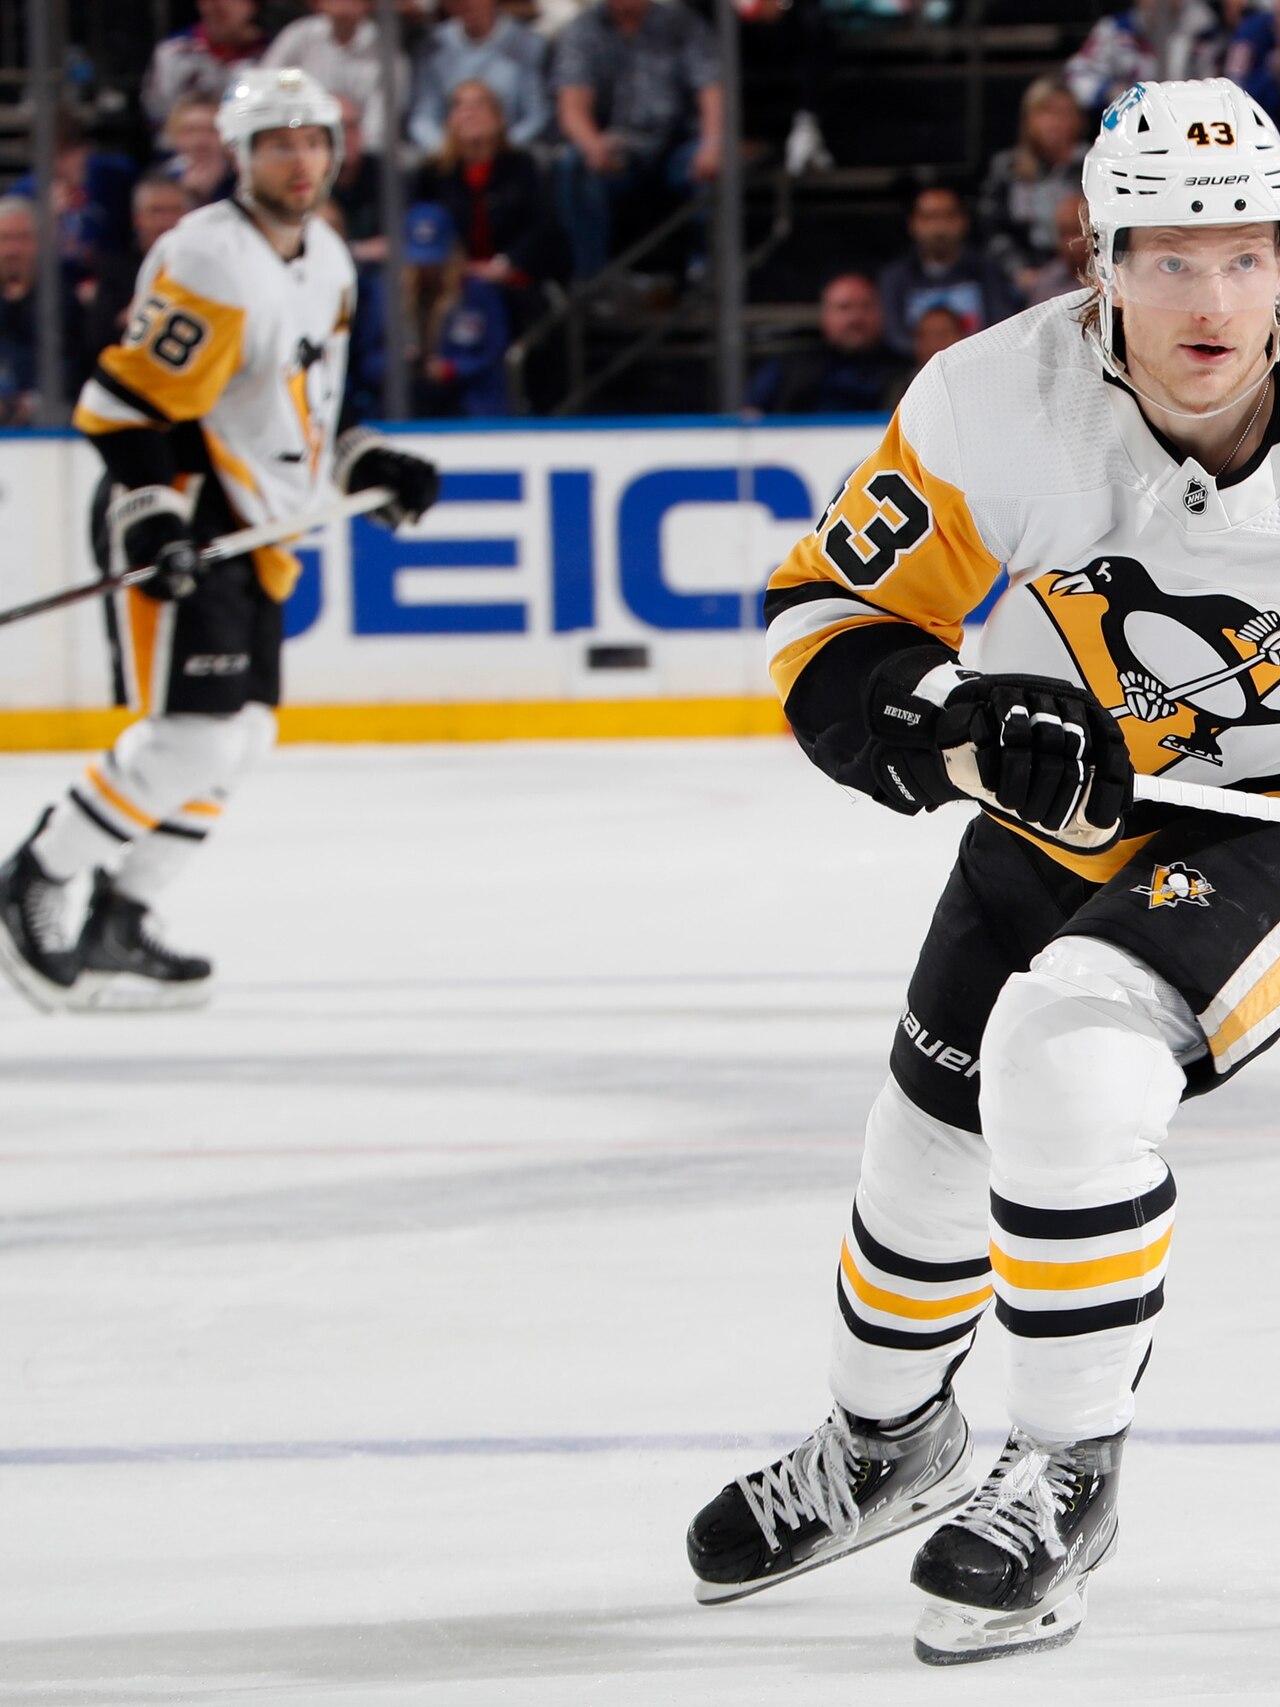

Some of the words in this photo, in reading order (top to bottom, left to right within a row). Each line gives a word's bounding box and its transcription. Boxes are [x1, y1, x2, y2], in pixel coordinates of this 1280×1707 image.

[1186, 120, 1236, 147] 43
[1184, 174, 1250, 187] BAUER
[1186, 490, 1206, 505] NHL
[814, 469, 933, 591] 3
[883, 704, 922, 727] HEINEN
[901, 1008, 981, 1078] AUE
